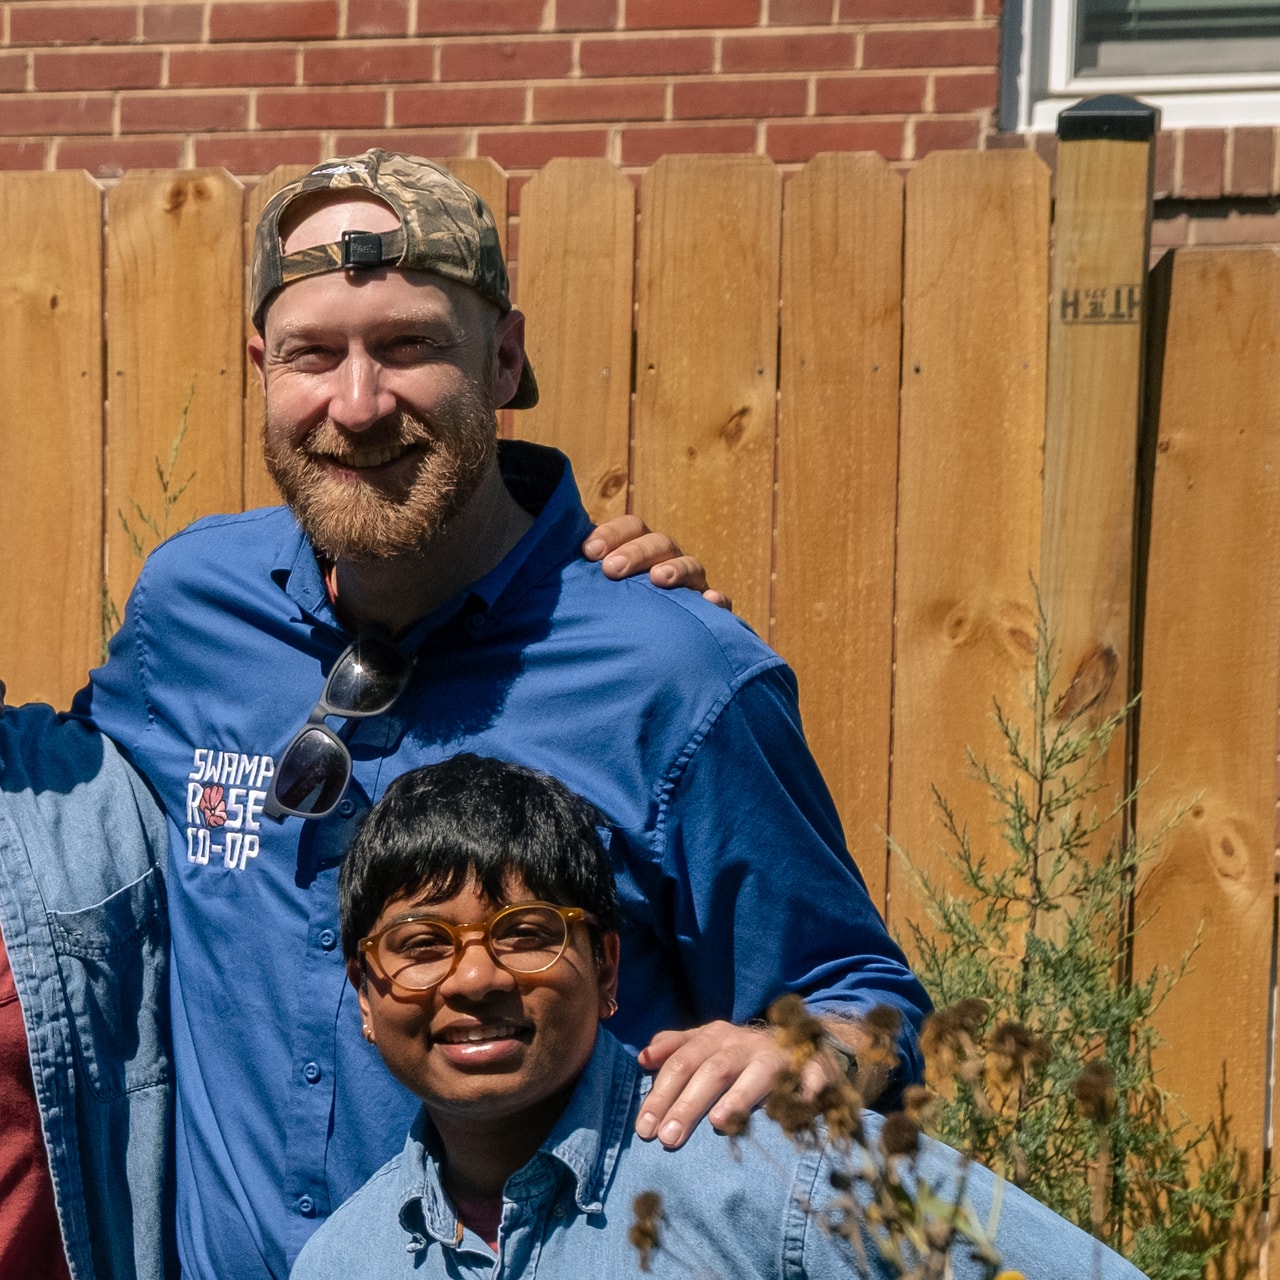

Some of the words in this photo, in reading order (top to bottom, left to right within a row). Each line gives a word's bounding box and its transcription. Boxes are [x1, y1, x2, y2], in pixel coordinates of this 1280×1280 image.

[189, 749, 274, 787] SWAMP
[187, 782, 268, 831] RSE
[187, 827, 260, 871] CO-OP
